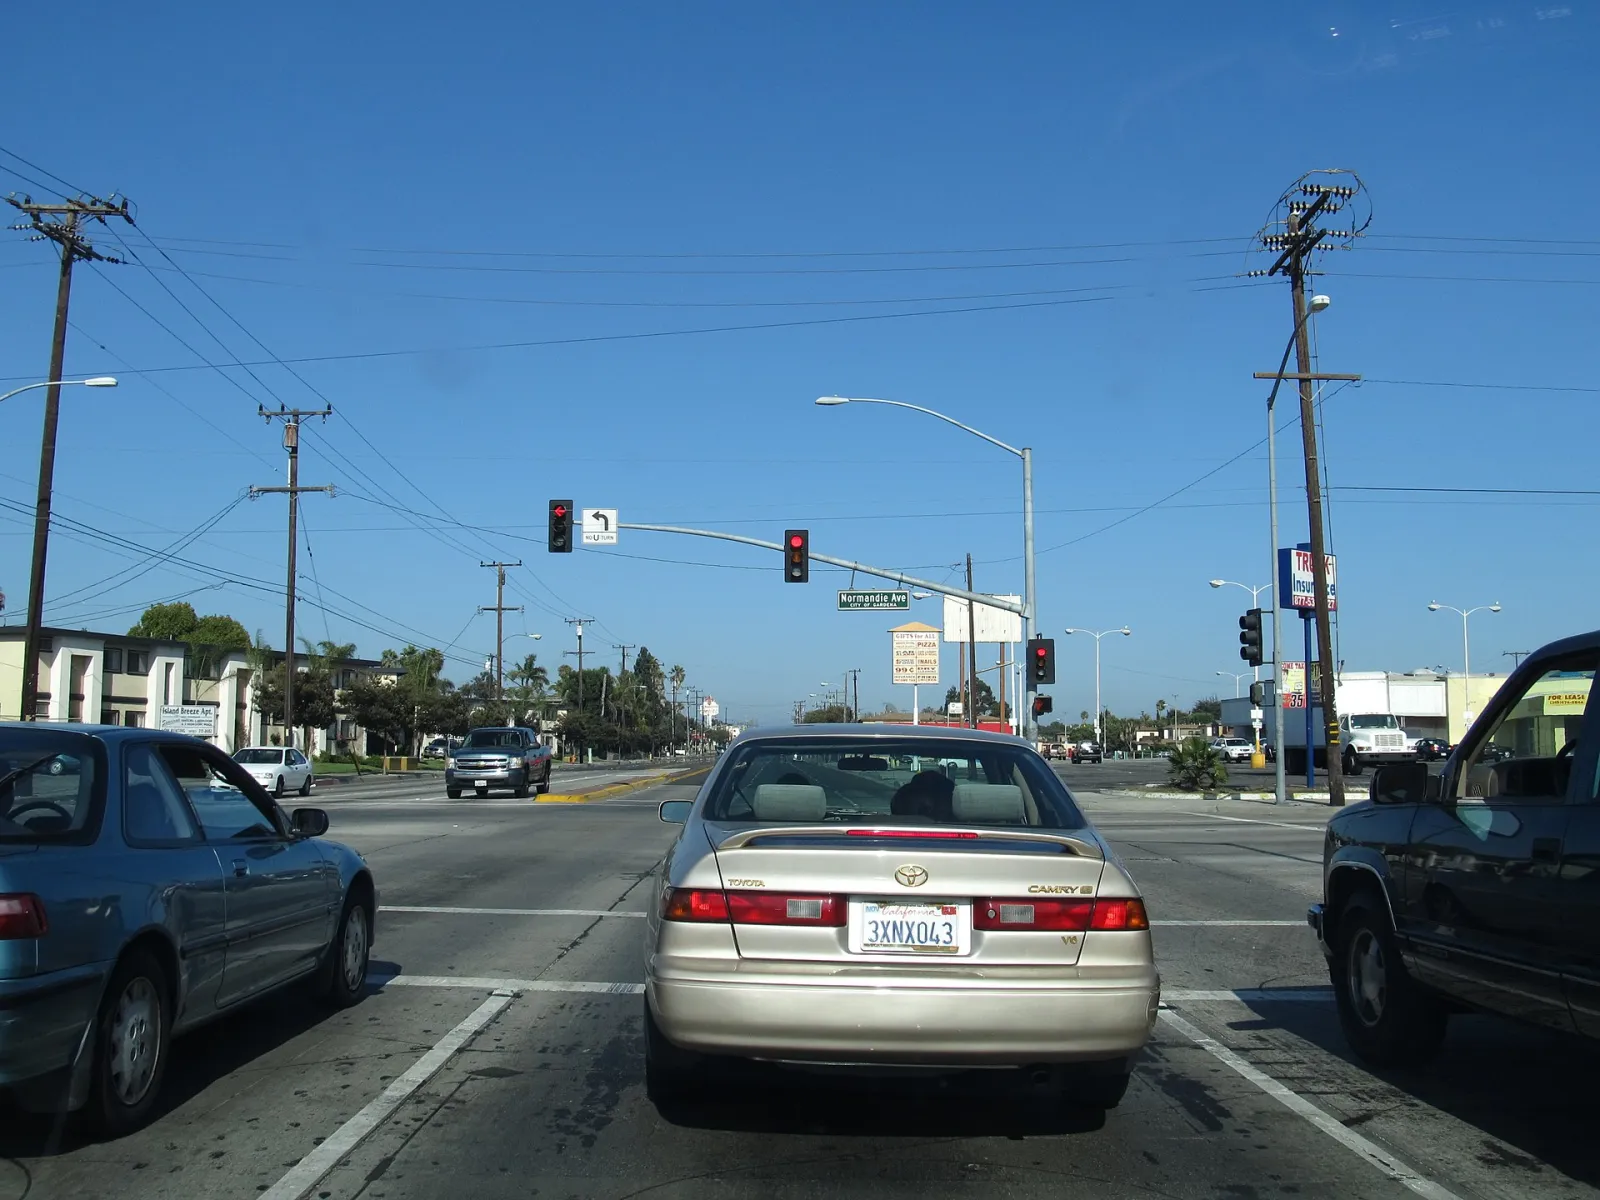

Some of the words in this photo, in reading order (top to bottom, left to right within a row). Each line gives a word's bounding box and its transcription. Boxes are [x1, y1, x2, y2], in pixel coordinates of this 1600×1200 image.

[1296, 552, 1330, 574] TRUK
[841, 593, 888, 602] Normandie
[891, 593, 906, 602] Ave
[1290, 694, 1304, 708] 35
[201, 708, 212, 716] Apt.
[728, 879, 765, 887] TOYOTA
[1028, 885, 1079, 894] CAMRY
[882, 906, 941, 919] California
[868, 920, 953, 944] 3XNX043
[1061, 936, 1077, 945] V6
